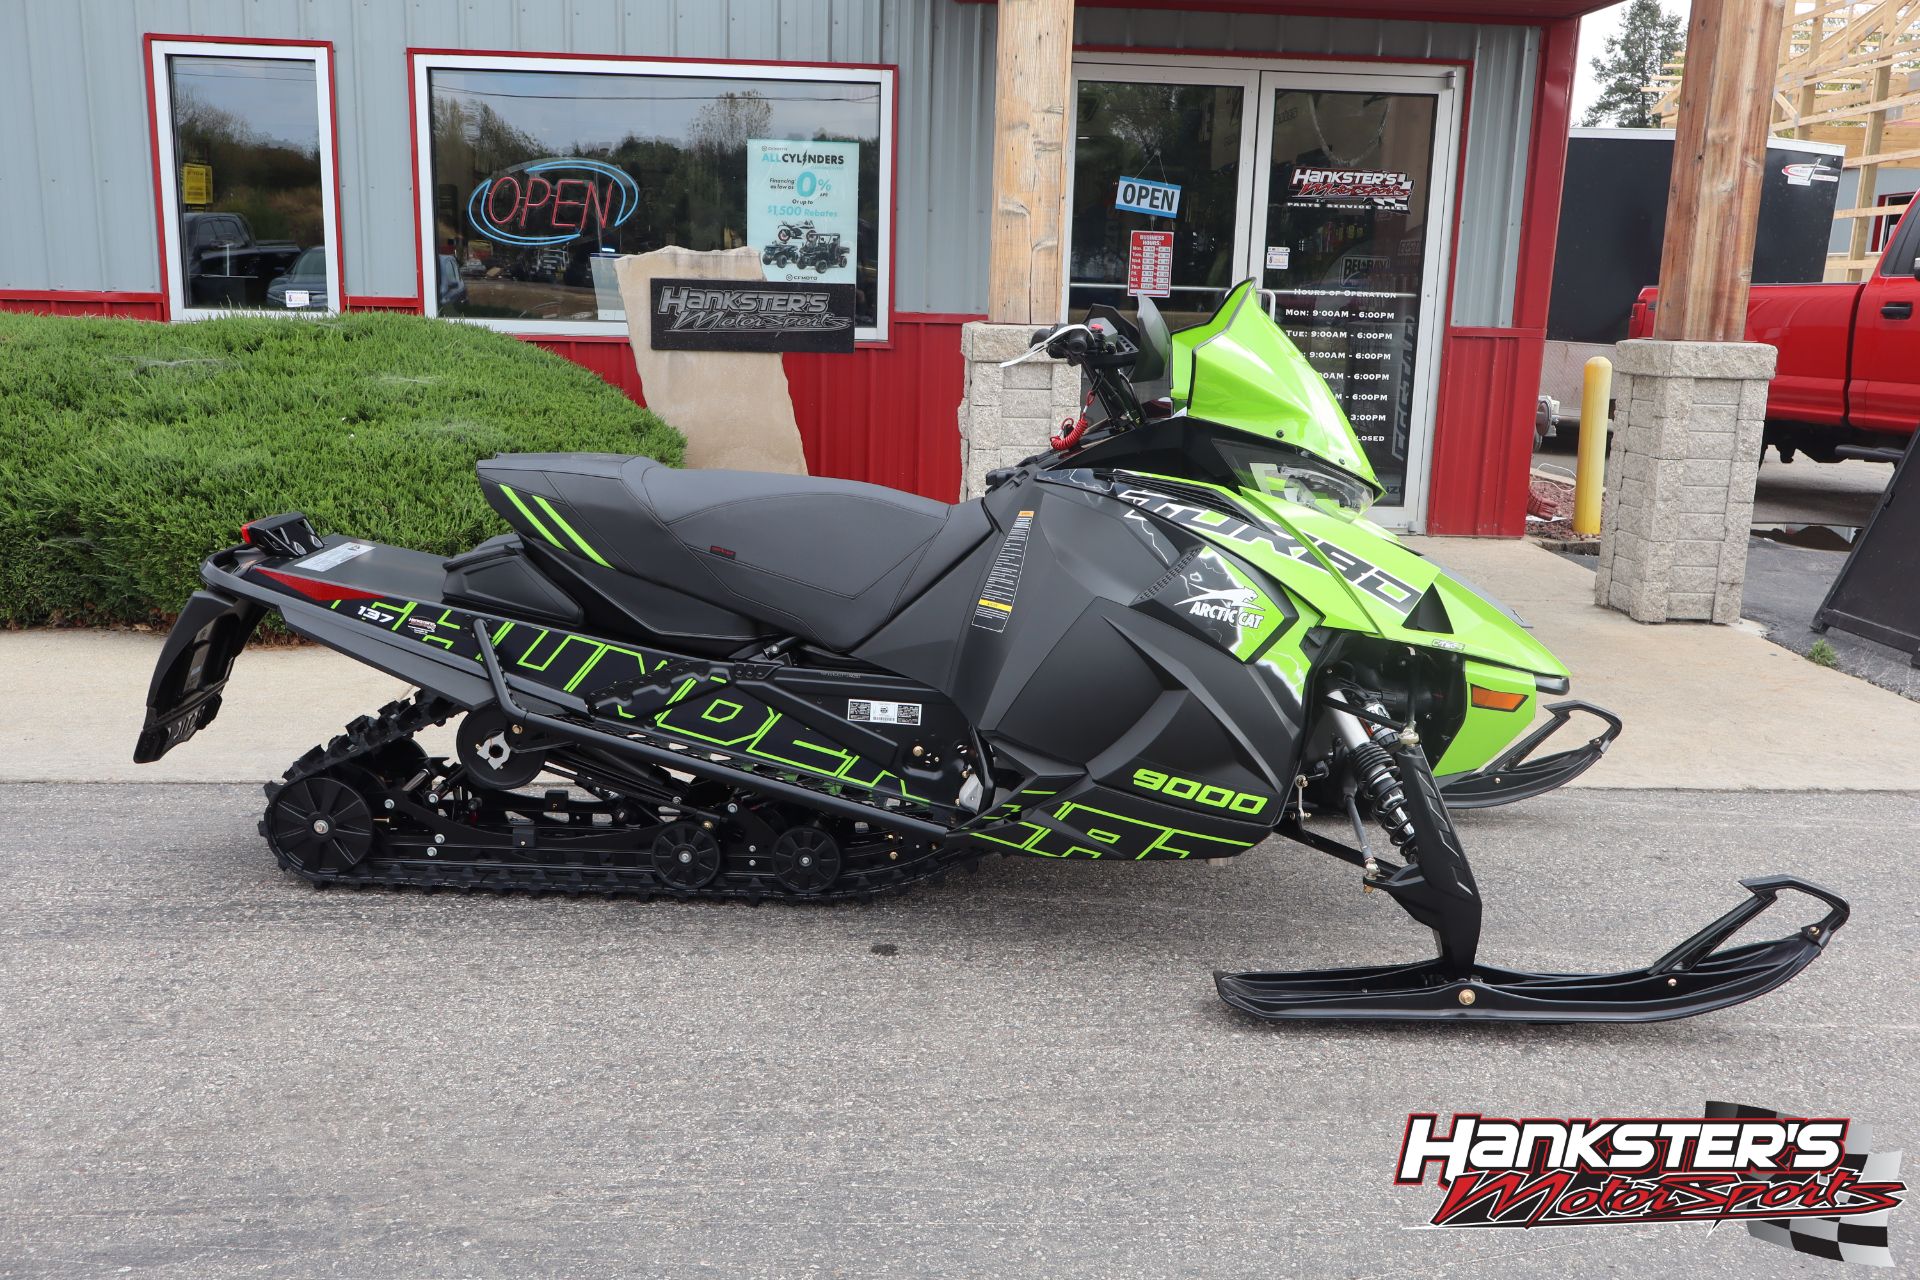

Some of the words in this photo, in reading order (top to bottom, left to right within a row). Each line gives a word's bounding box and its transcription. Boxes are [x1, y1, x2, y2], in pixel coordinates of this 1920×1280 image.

[489, 177, 615, 229] OPEN
[1122, 184, 1175, 211] OPEN
[1359, 311, 1395, 319] 6:00PM
[1357, 332, 1393, 340] 6:00PM
[1117, 489, 1423, 616] TURBO
[357, 605, 394, 623] 137
[1189, 601, 1237, 624] ARCTIC
[1238, 612, 1265, 629] CAT
[1133, 768, 1268, 815] 9000
